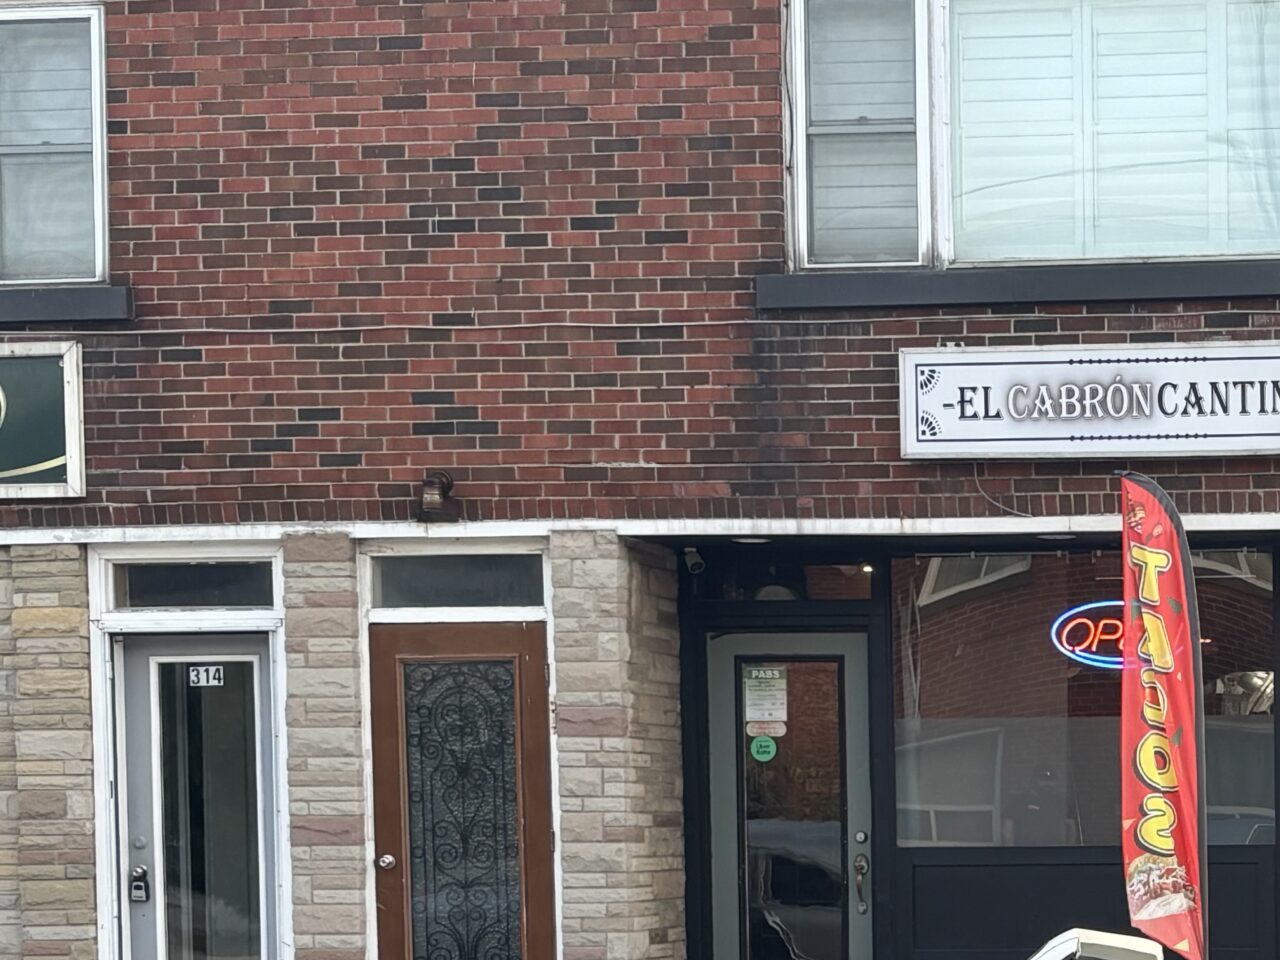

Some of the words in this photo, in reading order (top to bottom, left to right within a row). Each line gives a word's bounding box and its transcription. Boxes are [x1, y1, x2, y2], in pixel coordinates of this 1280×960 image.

[1007, 375, 1152, 422] CABRÓN
[1062, 617, 1126, 652] OP
[191, 667, 222, 685] 314
[751, 670, 780, 679] PASS
